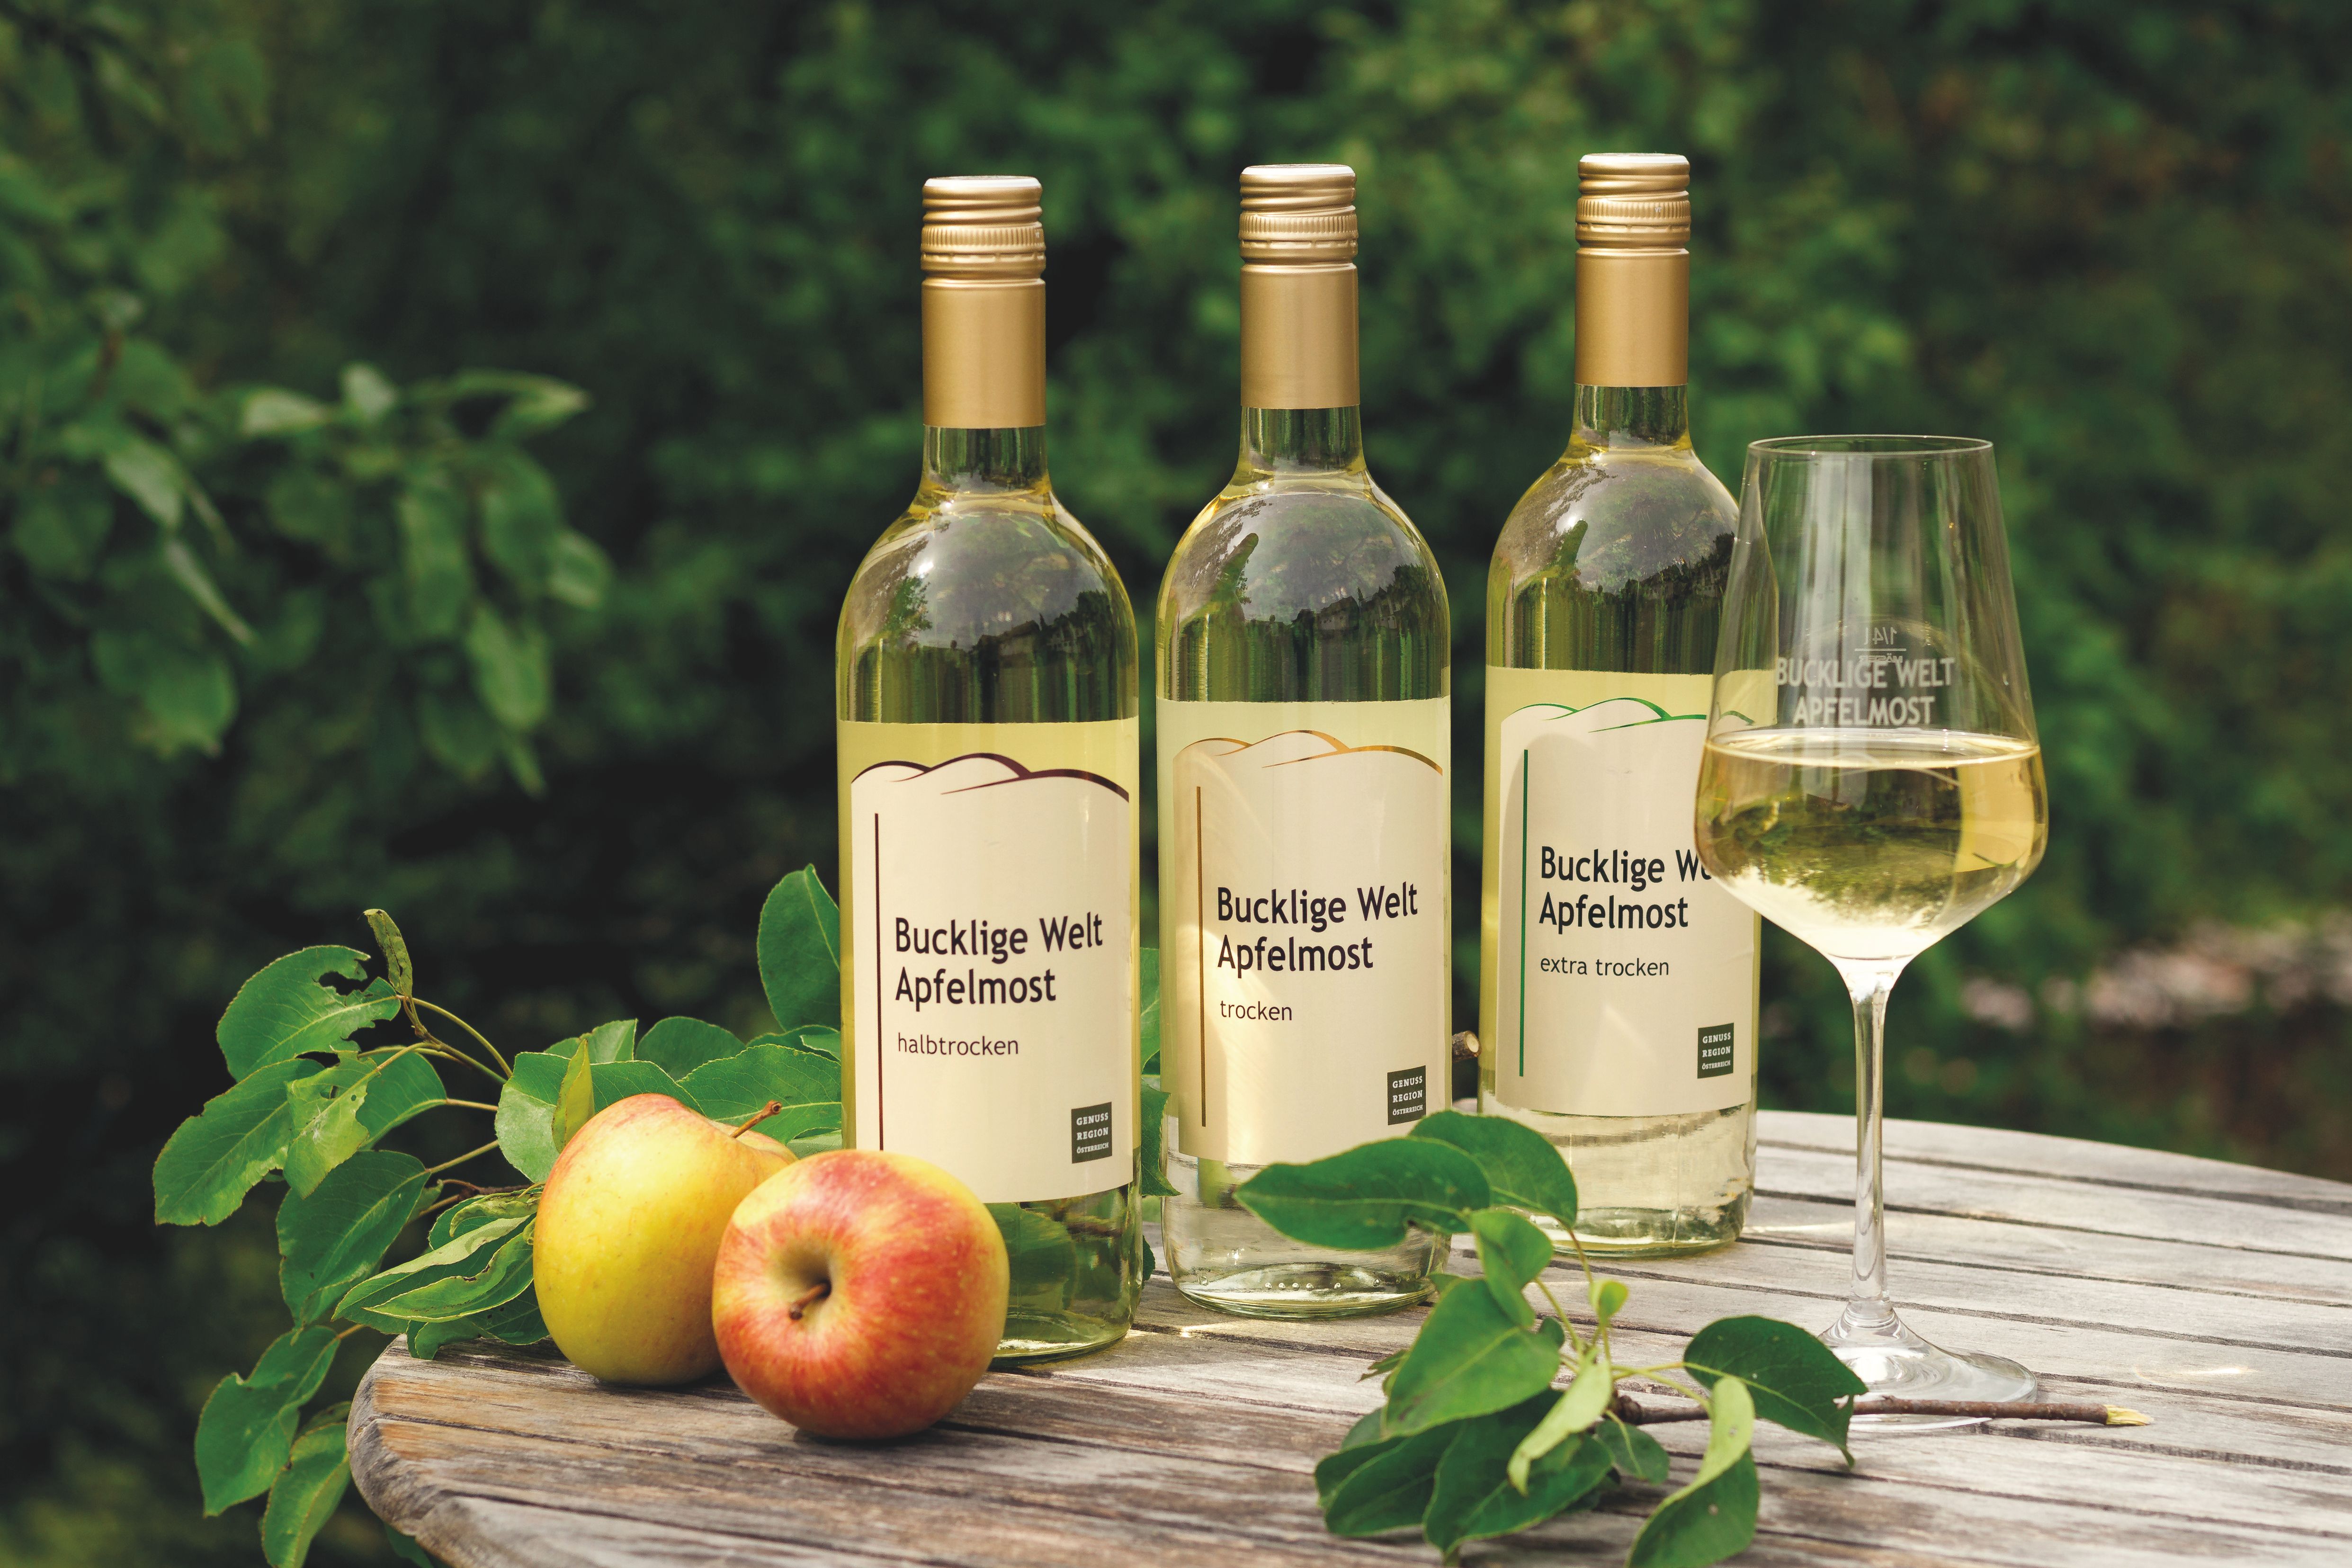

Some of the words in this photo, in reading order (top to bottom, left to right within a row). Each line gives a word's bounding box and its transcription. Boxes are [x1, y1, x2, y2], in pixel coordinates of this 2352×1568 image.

[1777, 657, 1887, 688] BUCKLIGE
[1895, 657, 1955, 688] WELT
[1793, 696, 1935, 725] APFELMOST
[1541, 846, 1665, 892] Bucklige
[1217, 887, 1346, 933] Bucklige
[1357, 881, 1418, 921] Welt
[1538, 891, 1688, 935] Apfelmost
[896, 917, 1028, 964] Bucklige
[1039, 912, 1103, 952] Welt
[1217, 934, 1373, 979] Apfelmost
[1540, 957, 1588, 975] extra
[1595, 958, 1669, 977] trocken
[895, 967, 1056, 1012] Apfelmost
[1220, 1001, 1292, 1021] trocken
[898, 1032, 1018, 1056] halbtrocken
[1702, 1032, 1731, 1044] GENUSS
[1702, 1046, 1731, 1057] REGION
[1702, 1060, 1731, 1070] ÖSTERREICH
[1392, 1075, 1422, 1088] GENUSS
[1393, 1090, 1423, 1103] REGION
[1076, 1112, 1109, 1125] GENUSS
[1393, 1104, 1423, 1115] ÖSTERREICH
[1076, 1127, 1109, 1140] REGION
[1076, 1142, 1109, 1154] ÖSTERREICH
